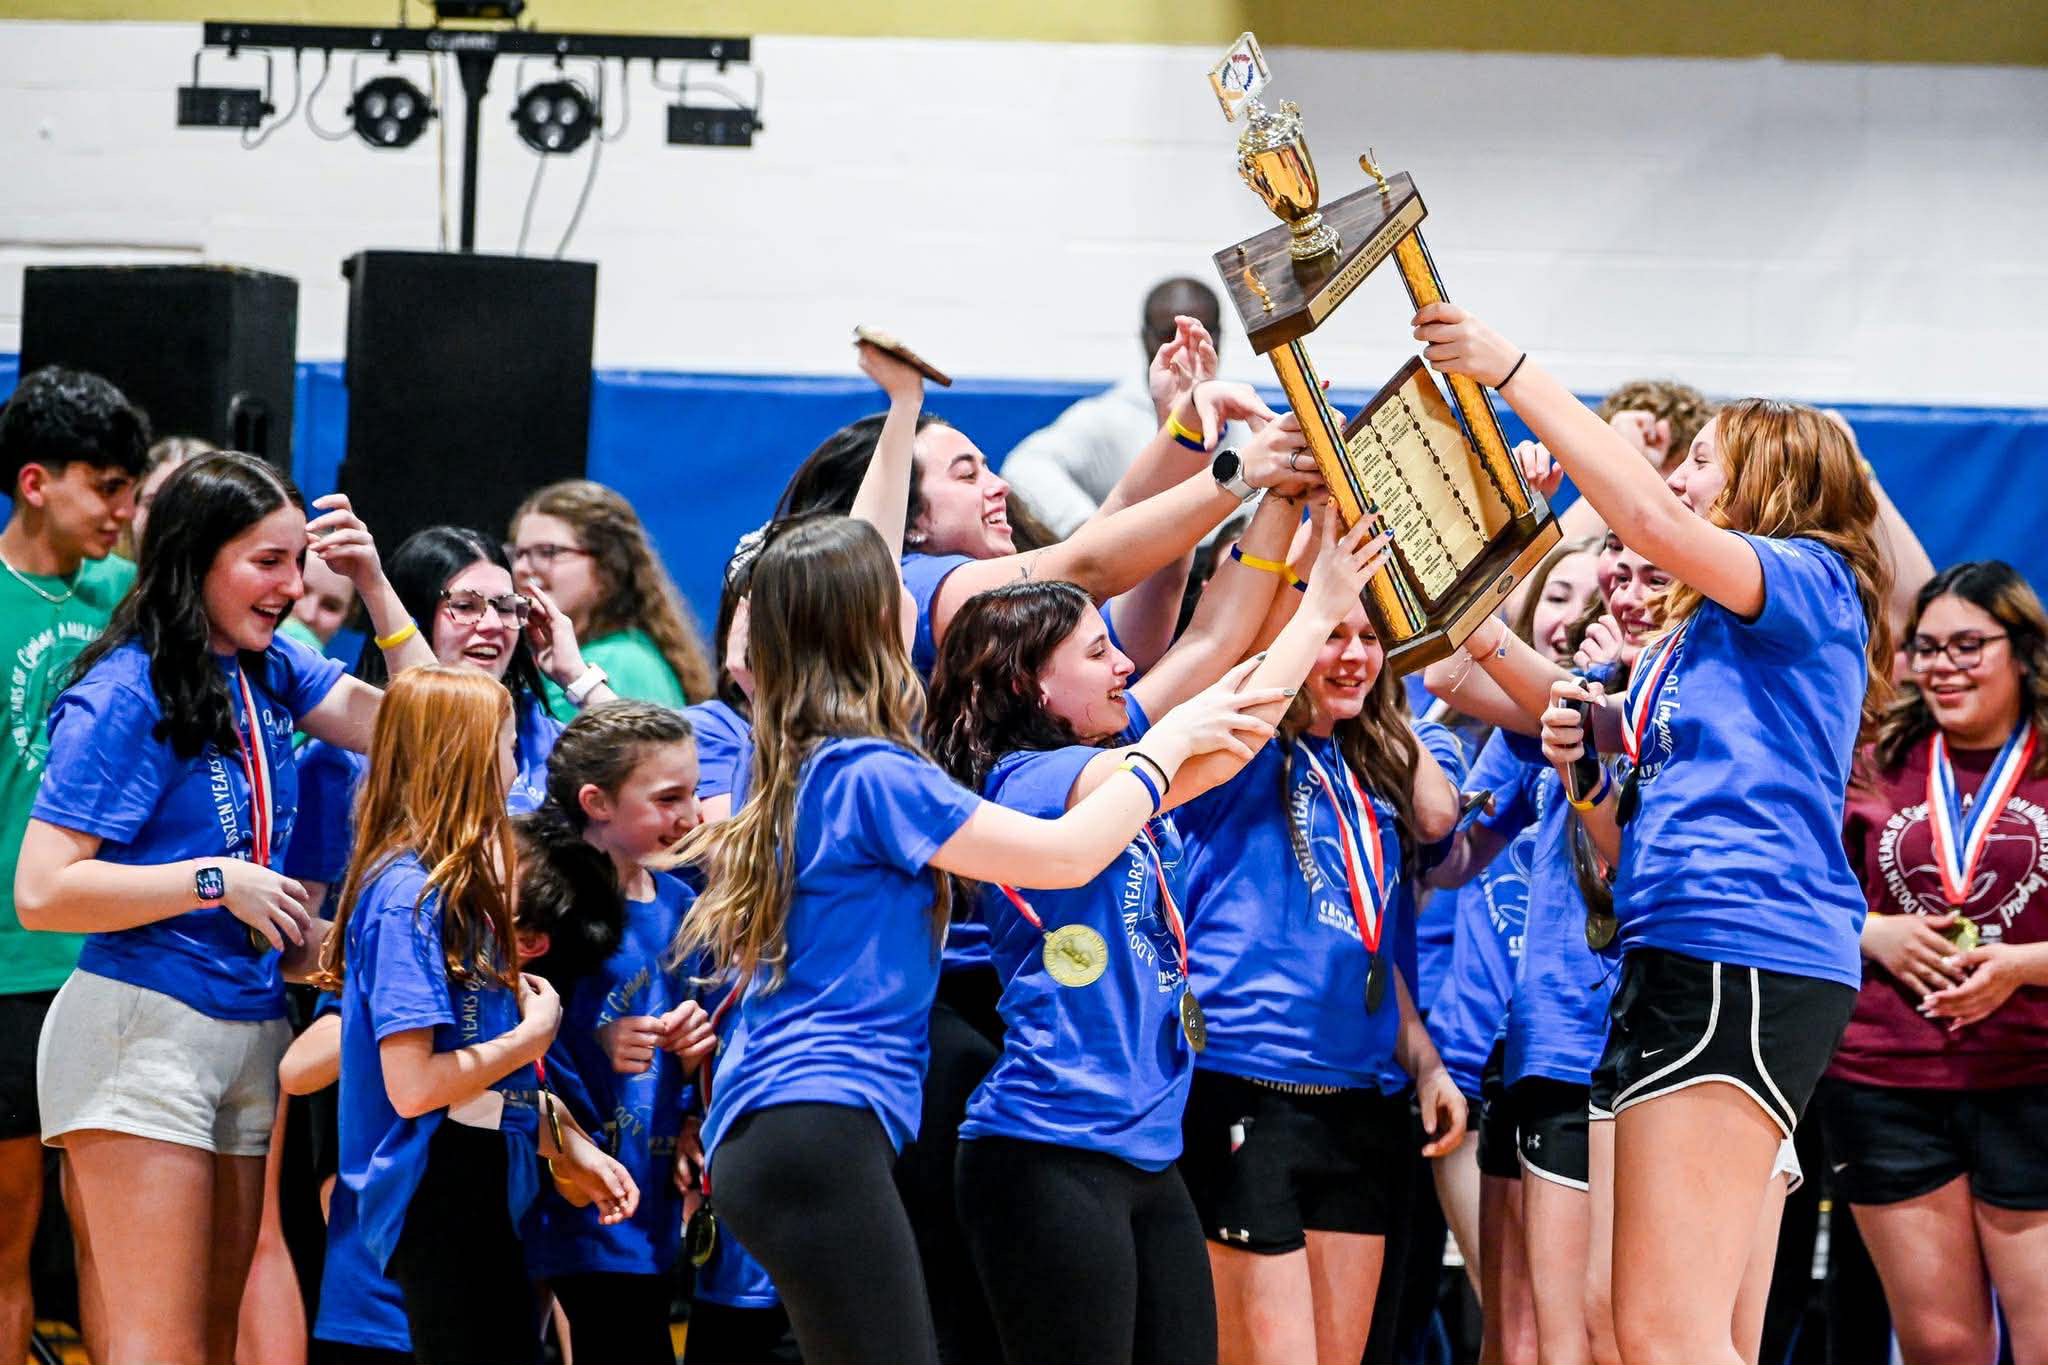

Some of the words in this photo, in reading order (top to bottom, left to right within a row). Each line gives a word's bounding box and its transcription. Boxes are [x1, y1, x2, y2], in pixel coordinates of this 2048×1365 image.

[1664, 674, 1680, 695] OF
[208, 759, 229, 805] YEARS
[1306, 769, 1321, 786] O
[1123, 859, 1144, 910] YEARS
[463, 995, 479, 1041] YEARS
